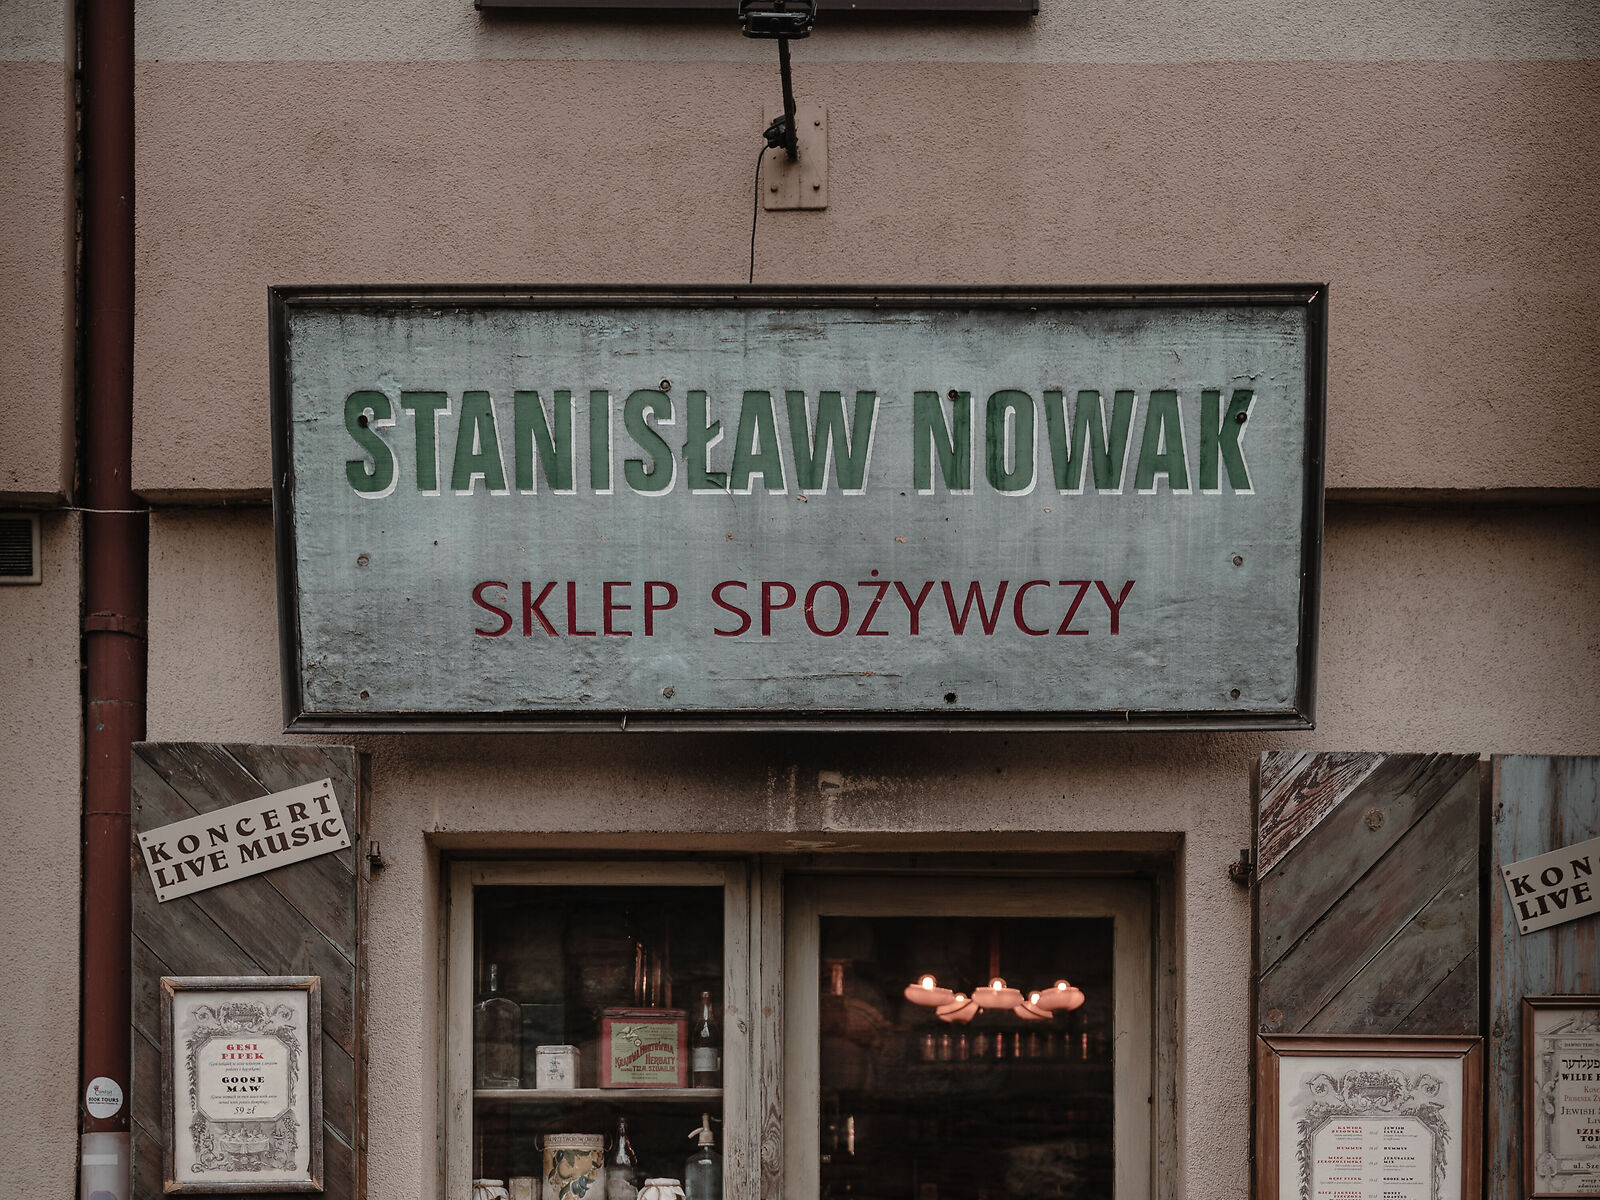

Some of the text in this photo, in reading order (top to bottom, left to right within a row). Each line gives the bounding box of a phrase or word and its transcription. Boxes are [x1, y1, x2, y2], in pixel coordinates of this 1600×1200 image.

[343, 389, 1257, 499] STANISŁAW NOWAK
[471, 569, 1136, 638] SKLEP SPOŻYWCZY
[147, 794, 331, 865] KONCERT
[154, 818, 342, 889] LIVE MUSIC
[1510, 856, 1600, 898] KON
[1517, 882, 1593, 921] LIVE
[221, 1076, 265, 1084] GOOSE
[1561, 1073, 1593, 1081] WILDE
[233, 1106, 245, 1115] 59
